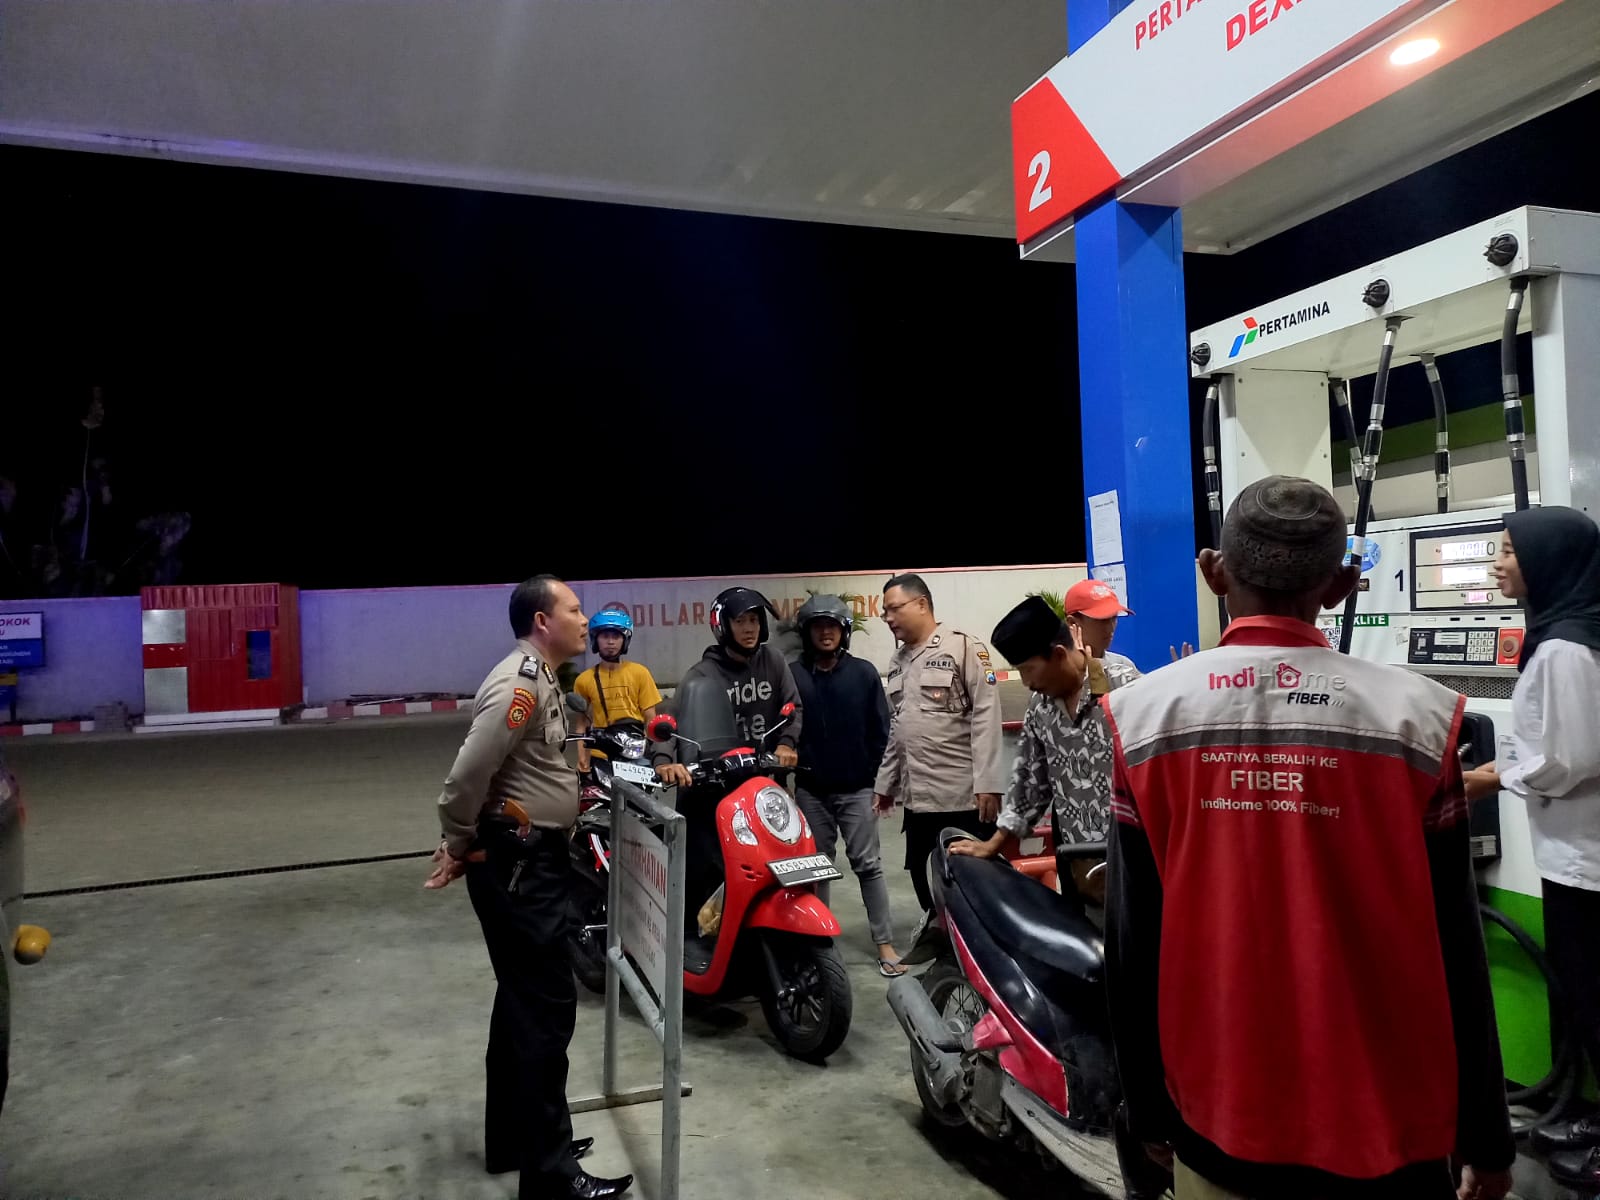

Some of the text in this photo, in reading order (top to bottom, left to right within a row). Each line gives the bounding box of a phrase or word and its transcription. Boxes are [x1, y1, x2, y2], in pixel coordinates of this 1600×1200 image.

[1226, 0, 1302, 51] DEX
[1028, 151, 1052, 212] 2
[1259, 302, 1330, 337] PERTAMINA
[1394, 569, 1404, 592] 1
[633, 603, 704, 627] DILAR
[1339, 615, 1386, 625] DXLITE
[1209, 663, 1346, 691] IndiHome
[726, 677, 772, 705] ride
[1287, 692, 1330, 705] FIBER
[736, 713, 765, 740] he
[1201, 752, 1338, 768] SAATNYA BERALIH KE
[1231, 770, 1304, 792] FIBER
[1201, 798, 1339, 818] IndiHome 100% Fiber!
